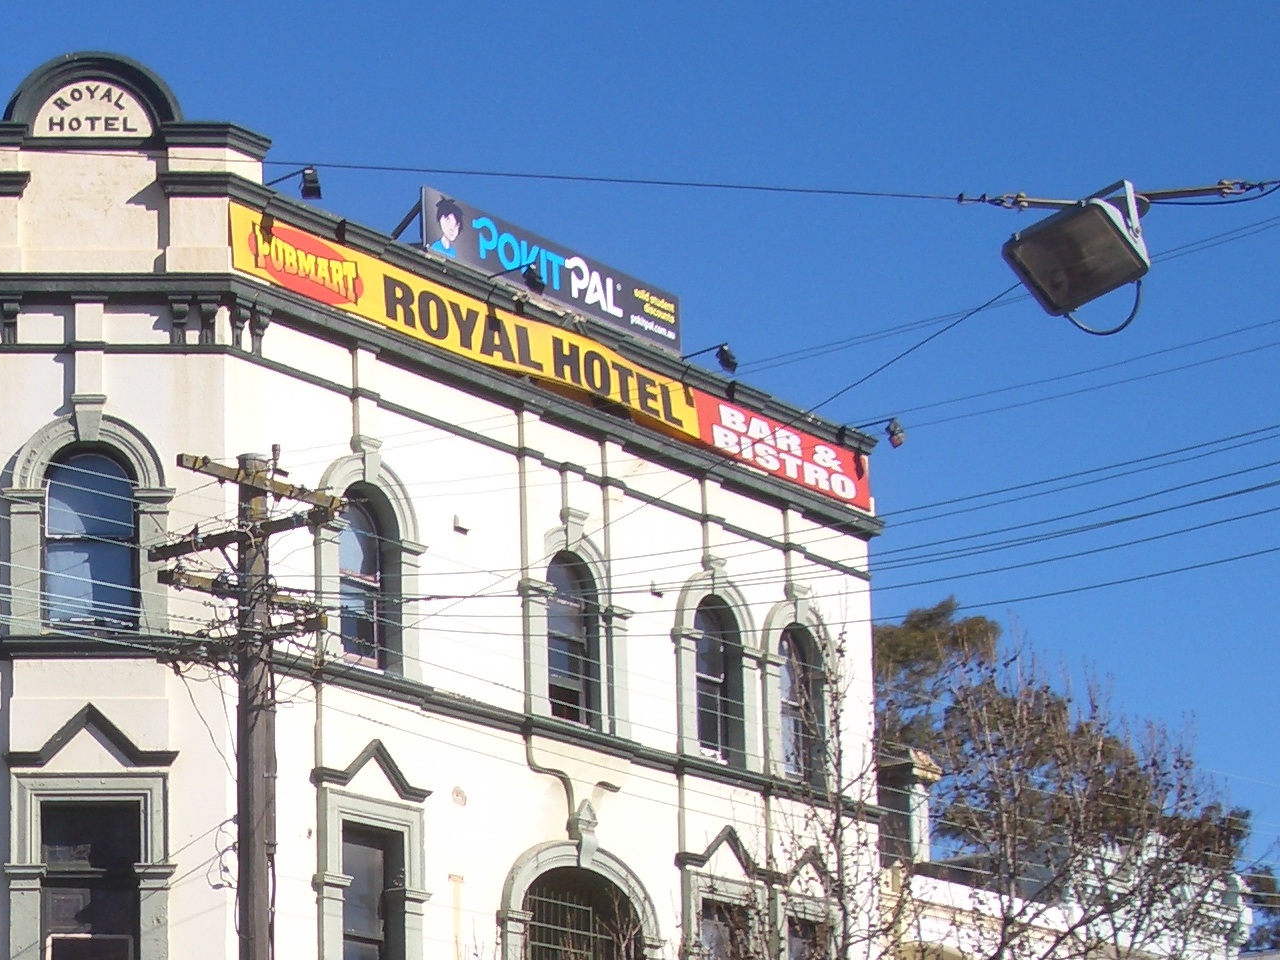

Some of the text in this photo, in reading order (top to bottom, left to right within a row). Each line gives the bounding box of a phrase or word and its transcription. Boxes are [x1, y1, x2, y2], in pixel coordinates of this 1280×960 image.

[48, 116, 138, 132] HOTEL
[52, 85, 126, 111] ROYAL
[251, 220, 360, 306] PUBMART
[382, 274, 684, 430] ROYAL HOTEL
[712, 423, 857, 500] BISTRO
[718, 403, 844, 473] BAR &
